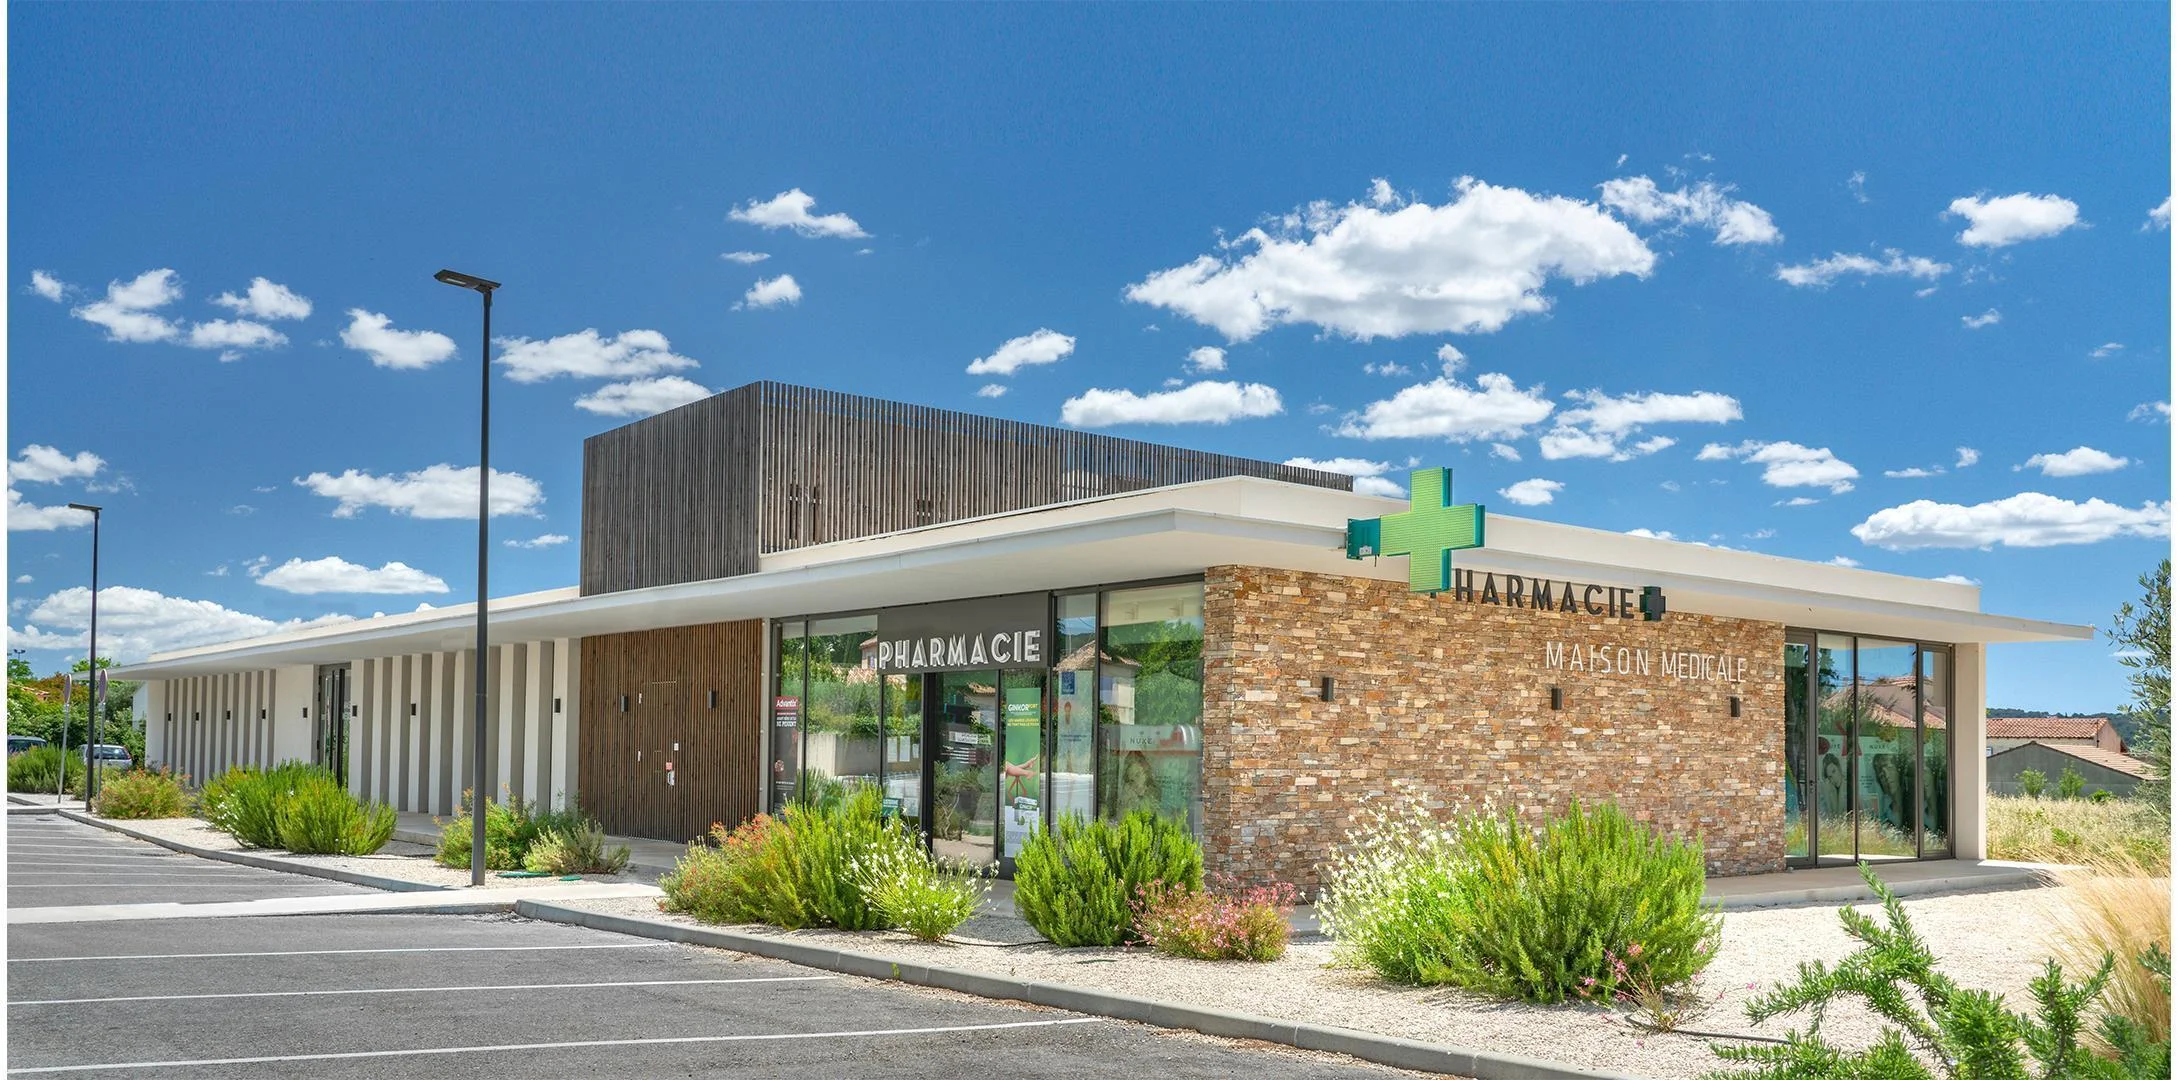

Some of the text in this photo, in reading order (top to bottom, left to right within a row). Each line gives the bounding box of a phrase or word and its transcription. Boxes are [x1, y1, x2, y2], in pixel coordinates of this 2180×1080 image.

[1430, 568, 1635, 619] HARMACIE
[879, 629, 1041, 670] PHARMACIE
[1546, 641, 1747, 683] MAISON MEDICALE
[1130, 736, 1153, 745] NUXE
